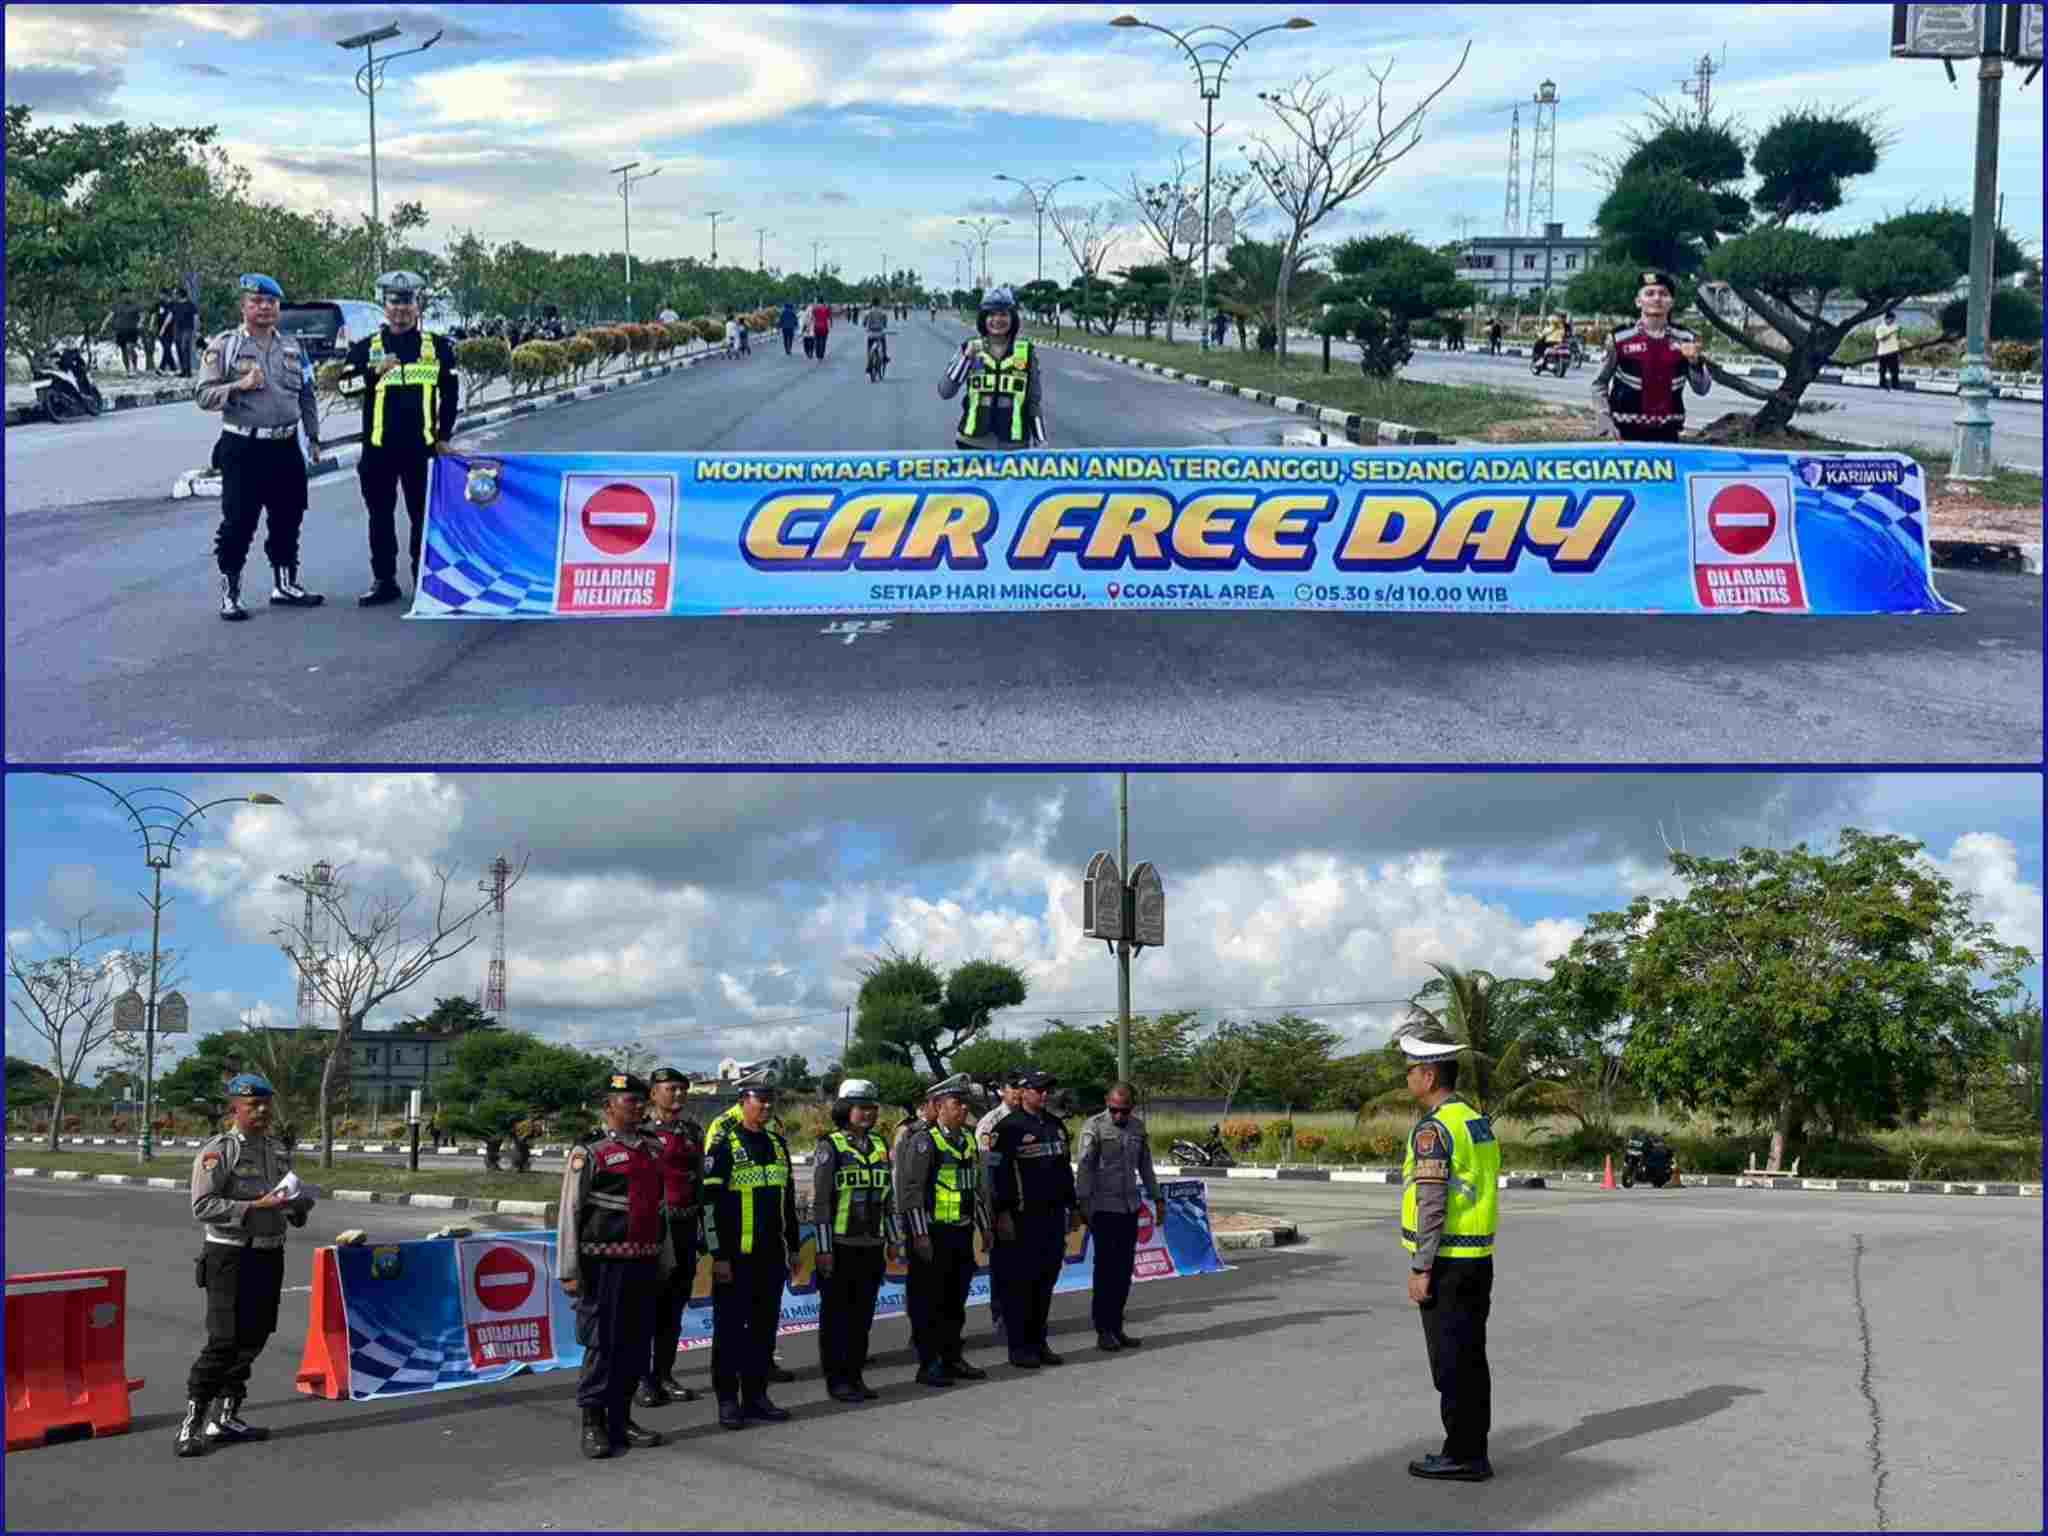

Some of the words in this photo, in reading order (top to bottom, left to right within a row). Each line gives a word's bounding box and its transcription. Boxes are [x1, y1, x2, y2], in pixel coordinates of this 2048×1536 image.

[697, 460, 804, 481] MOHON
[810, 460, 892, 480] MAAF
[898, 457, 1079, 479] PERJALANAN
[1085, 457, 1164, 479] ANDA
[1168, 457, 1347, 484] TERGANGGU,
[1351, 459, 1466, 481] SEDANG
[1469, 459, 1531, 481] ADA
[1536, 459, 1675, 481] KEGIATAN
[1825, 469, 1899, 484] KARIMUN
[741, 488, 997, 572] CAR
[1008, 489, 1338, 570] FREE
[1333, 489, 1636, 572] DAY
[573, 567, 656, 588] DILARANG
[1706, 567, 1787, 587] DILARANG
[572, 587, 656, 606] MELINTAS
[869, 584, 942, 600] SETIAP
[947, 584, 996, 600] HARI
[1000, 583, 1088, 600] MINGGU,
[1122, 583, 1216, 600] COASTAL
[1218, 584, 1275, 600] AREA
[1315, 585, 1369, 601] 05.30
[1374, 584, 1404, 601] s/d
[1408, 585, 1463, 601] 10.00
[1466, 586, 1510, 602] WIB
[1711, 586, 1791, 605] MELINTAS
